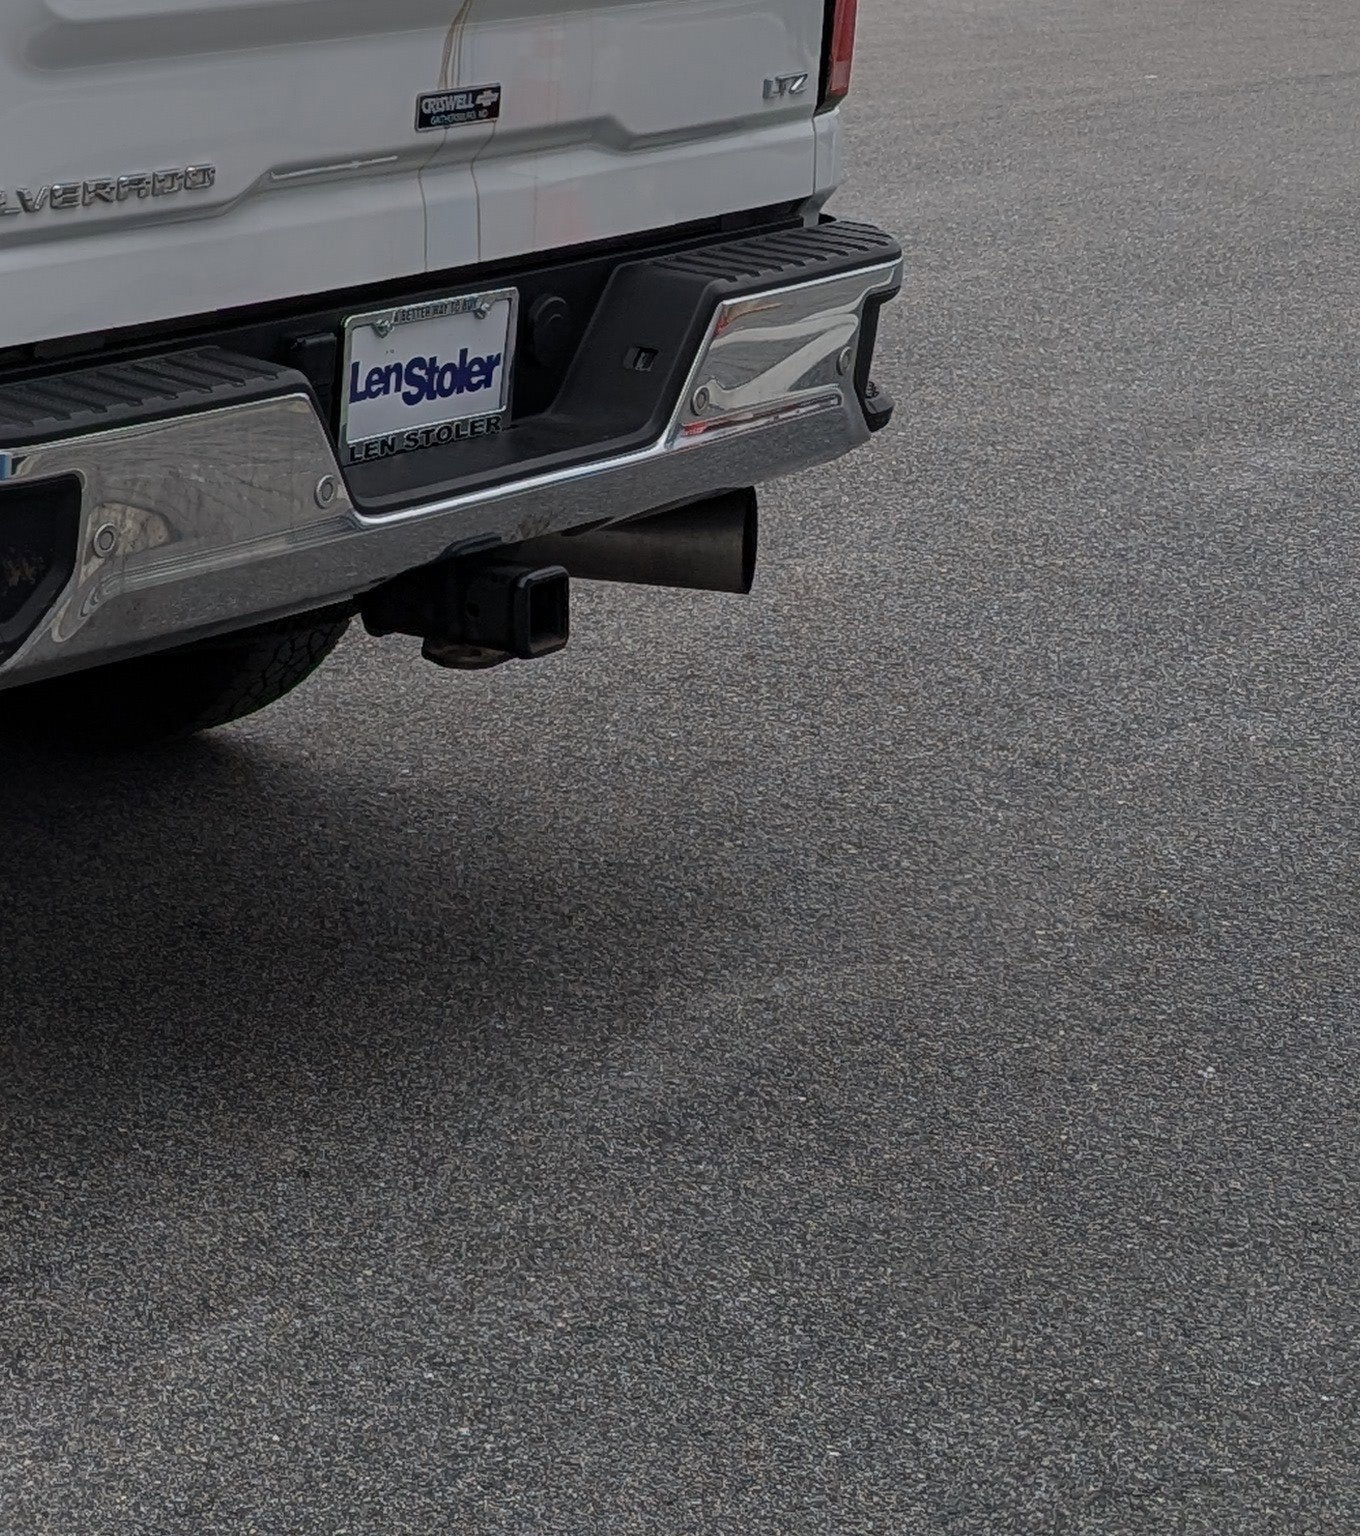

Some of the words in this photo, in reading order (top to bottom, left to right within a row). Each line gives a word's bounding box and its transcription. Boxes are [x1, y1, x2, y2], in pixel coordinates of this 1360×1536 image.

[762, 73, 808, 100] LTZ
[421, 92, 475, 115] CRISWELL
[349, 436, 396, 463] LEN
[404, 416, 503, 451] STOLER
